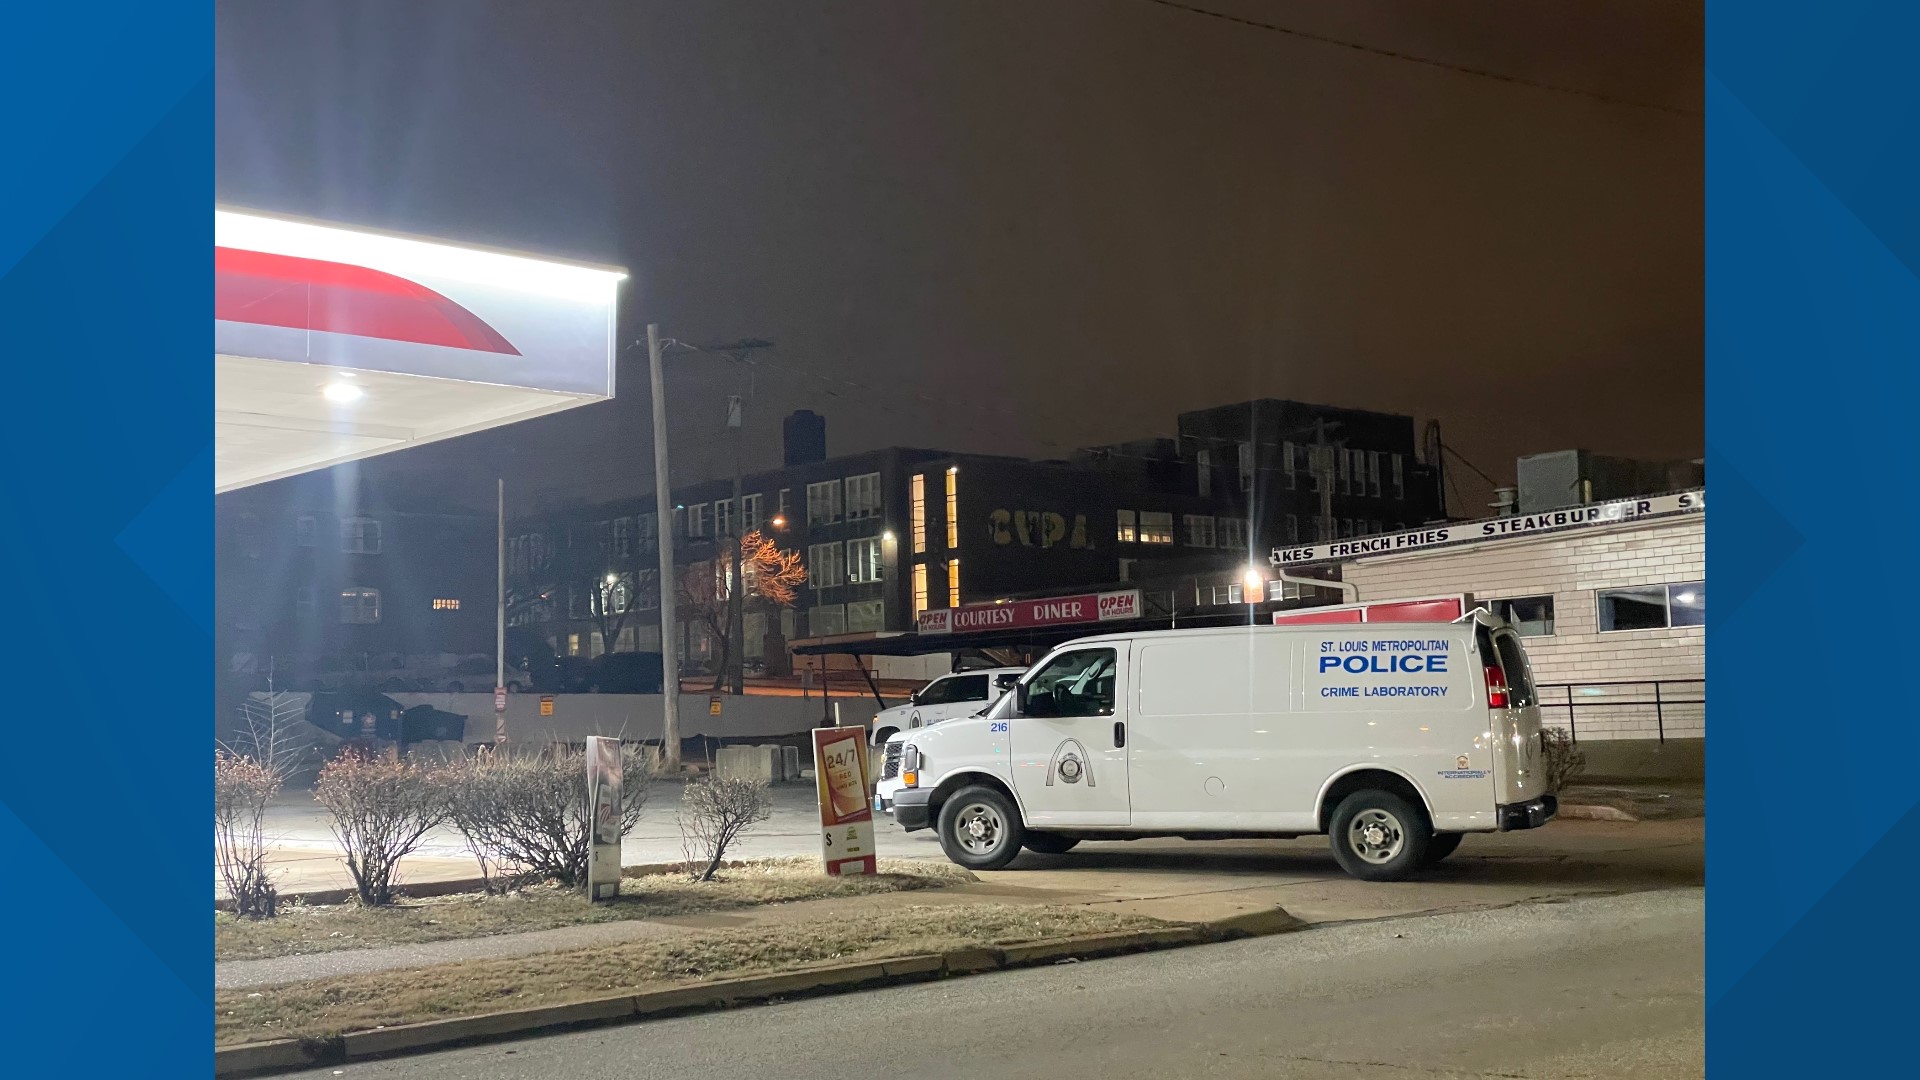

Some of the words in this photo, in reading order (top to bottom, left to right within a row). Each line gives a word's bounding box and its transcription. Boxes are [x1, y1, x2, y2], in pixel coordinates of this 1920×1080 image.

[1329, 538, 1391, 557] FRENCH
[1396, 529, 1449, 547] FRIES
[1482, 499, 1652, 536] STEAKBURGER
[1100, 594, 1134, 610] OPEN
[919, 612, 947, 625] OPEN
[954, 608, 1015, 627] COURTESY
[1033, 601, 1082, 620] DINER
[1111, 607, 1134, 616] HOURS
[1320, 641, 1336, 653] ST.
[1339, 640, 1368, 652] LOUIS
[1372, 639, 1449, 652] METROPOLITAN
[1319, 654, 1448, 674] POLICE
[1320, 687, 1360, 697] CRIME
[1364, 686, 1448, 697] LABORATORY
[990, 722, 1008, 732] 216
[826, 749, 855, 769] 24/7
[825, 832, 833, 847] $
